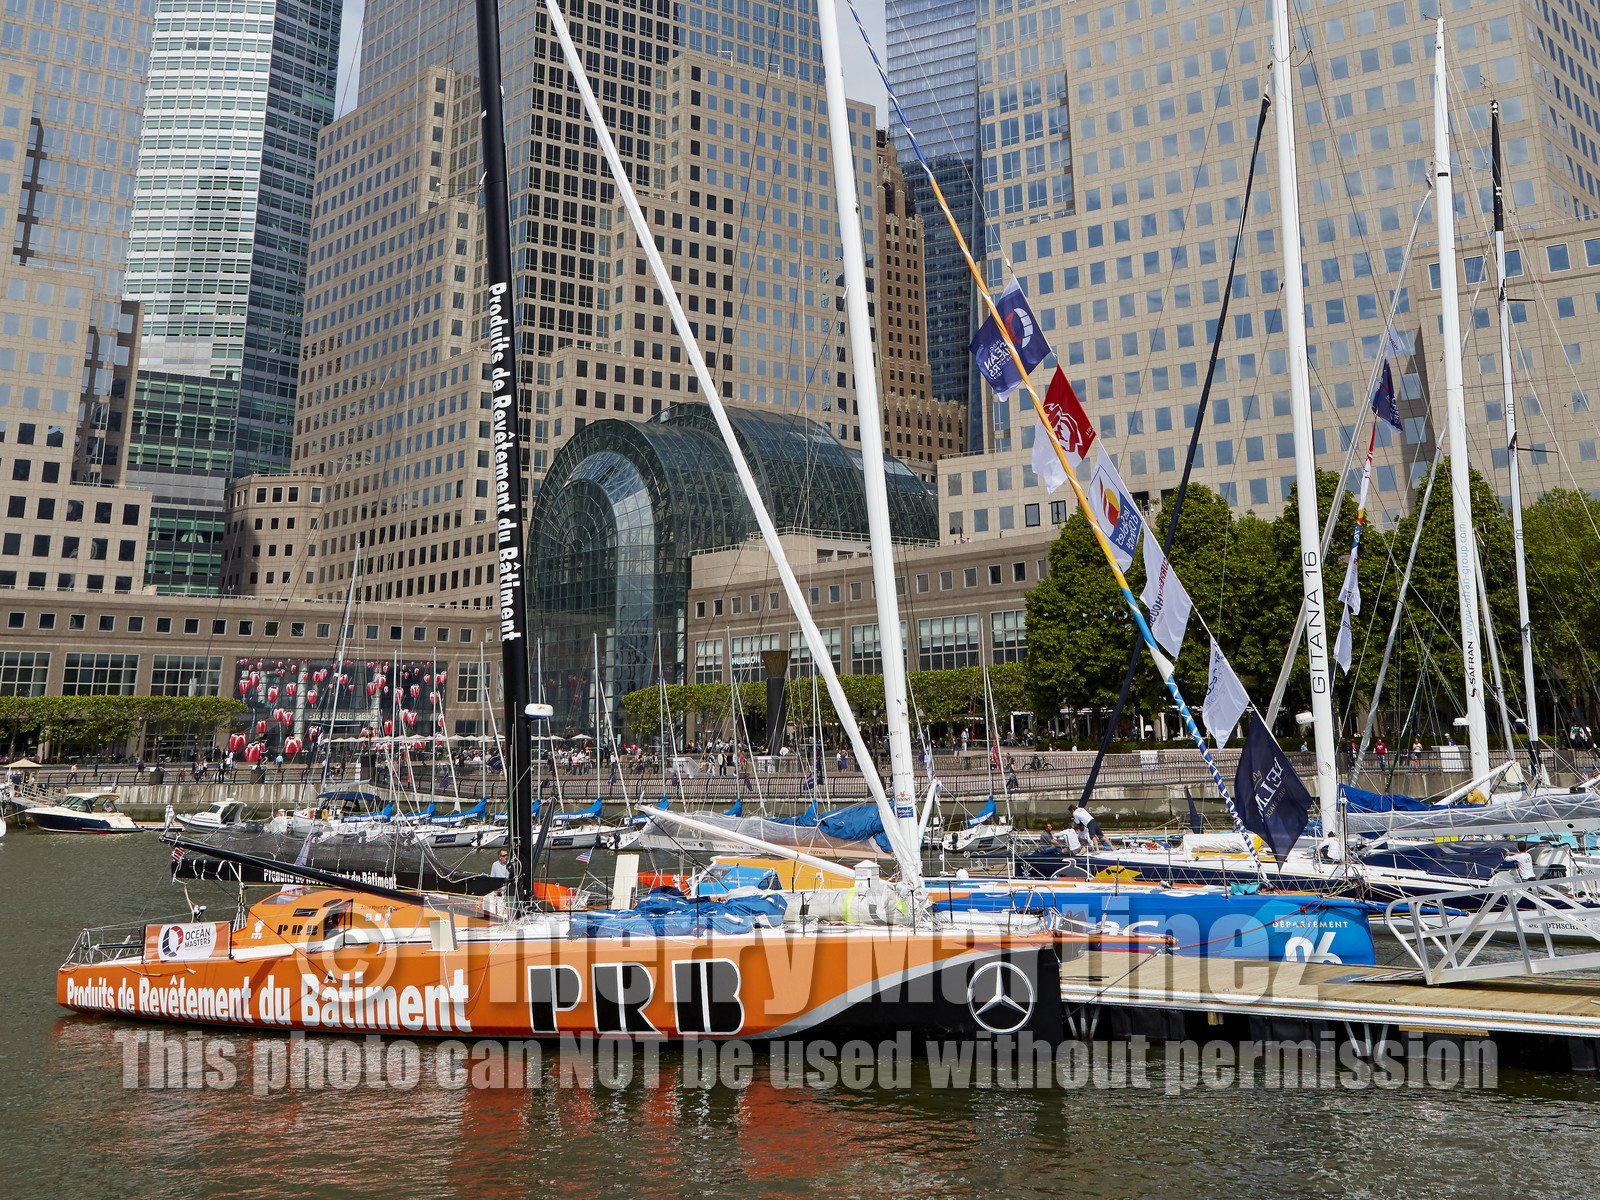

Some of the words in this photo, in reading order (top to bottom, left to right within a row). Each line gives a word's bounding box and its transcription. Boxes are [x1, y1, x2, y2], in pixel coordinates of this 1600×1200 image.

[489, 282, 510, 364] Produits
[492, 367, 511, 392] de
[493, 394, 516, 515] Revêtement
[497, 518, 517, 543] du
[1303, 551, 1318, 577] 16
[1458, 523, 1474, 636] www.safran-group.com
[499, 547, 521, 641] Bâtiment
[1307, 588, 1326, 694] GITANA
[1467, 641, 1476, 685] SAFRAN
[362, 871, 397, 890] Bâtiment
[184, 937, 211, 948] MASTERS
[185, 927, 211, 941] OCEAN
[277, 924, 319, 936] PRB
[66, 977, 115, 1011] Produits
[118, 977, 136, 1014] de
[138, 974, 252, 1023] Revêtement
[259, 974, 292, 1026] du
[301, 969, 473, 1033] Bâtiment
[527, 957, 746, 1036] PRB
